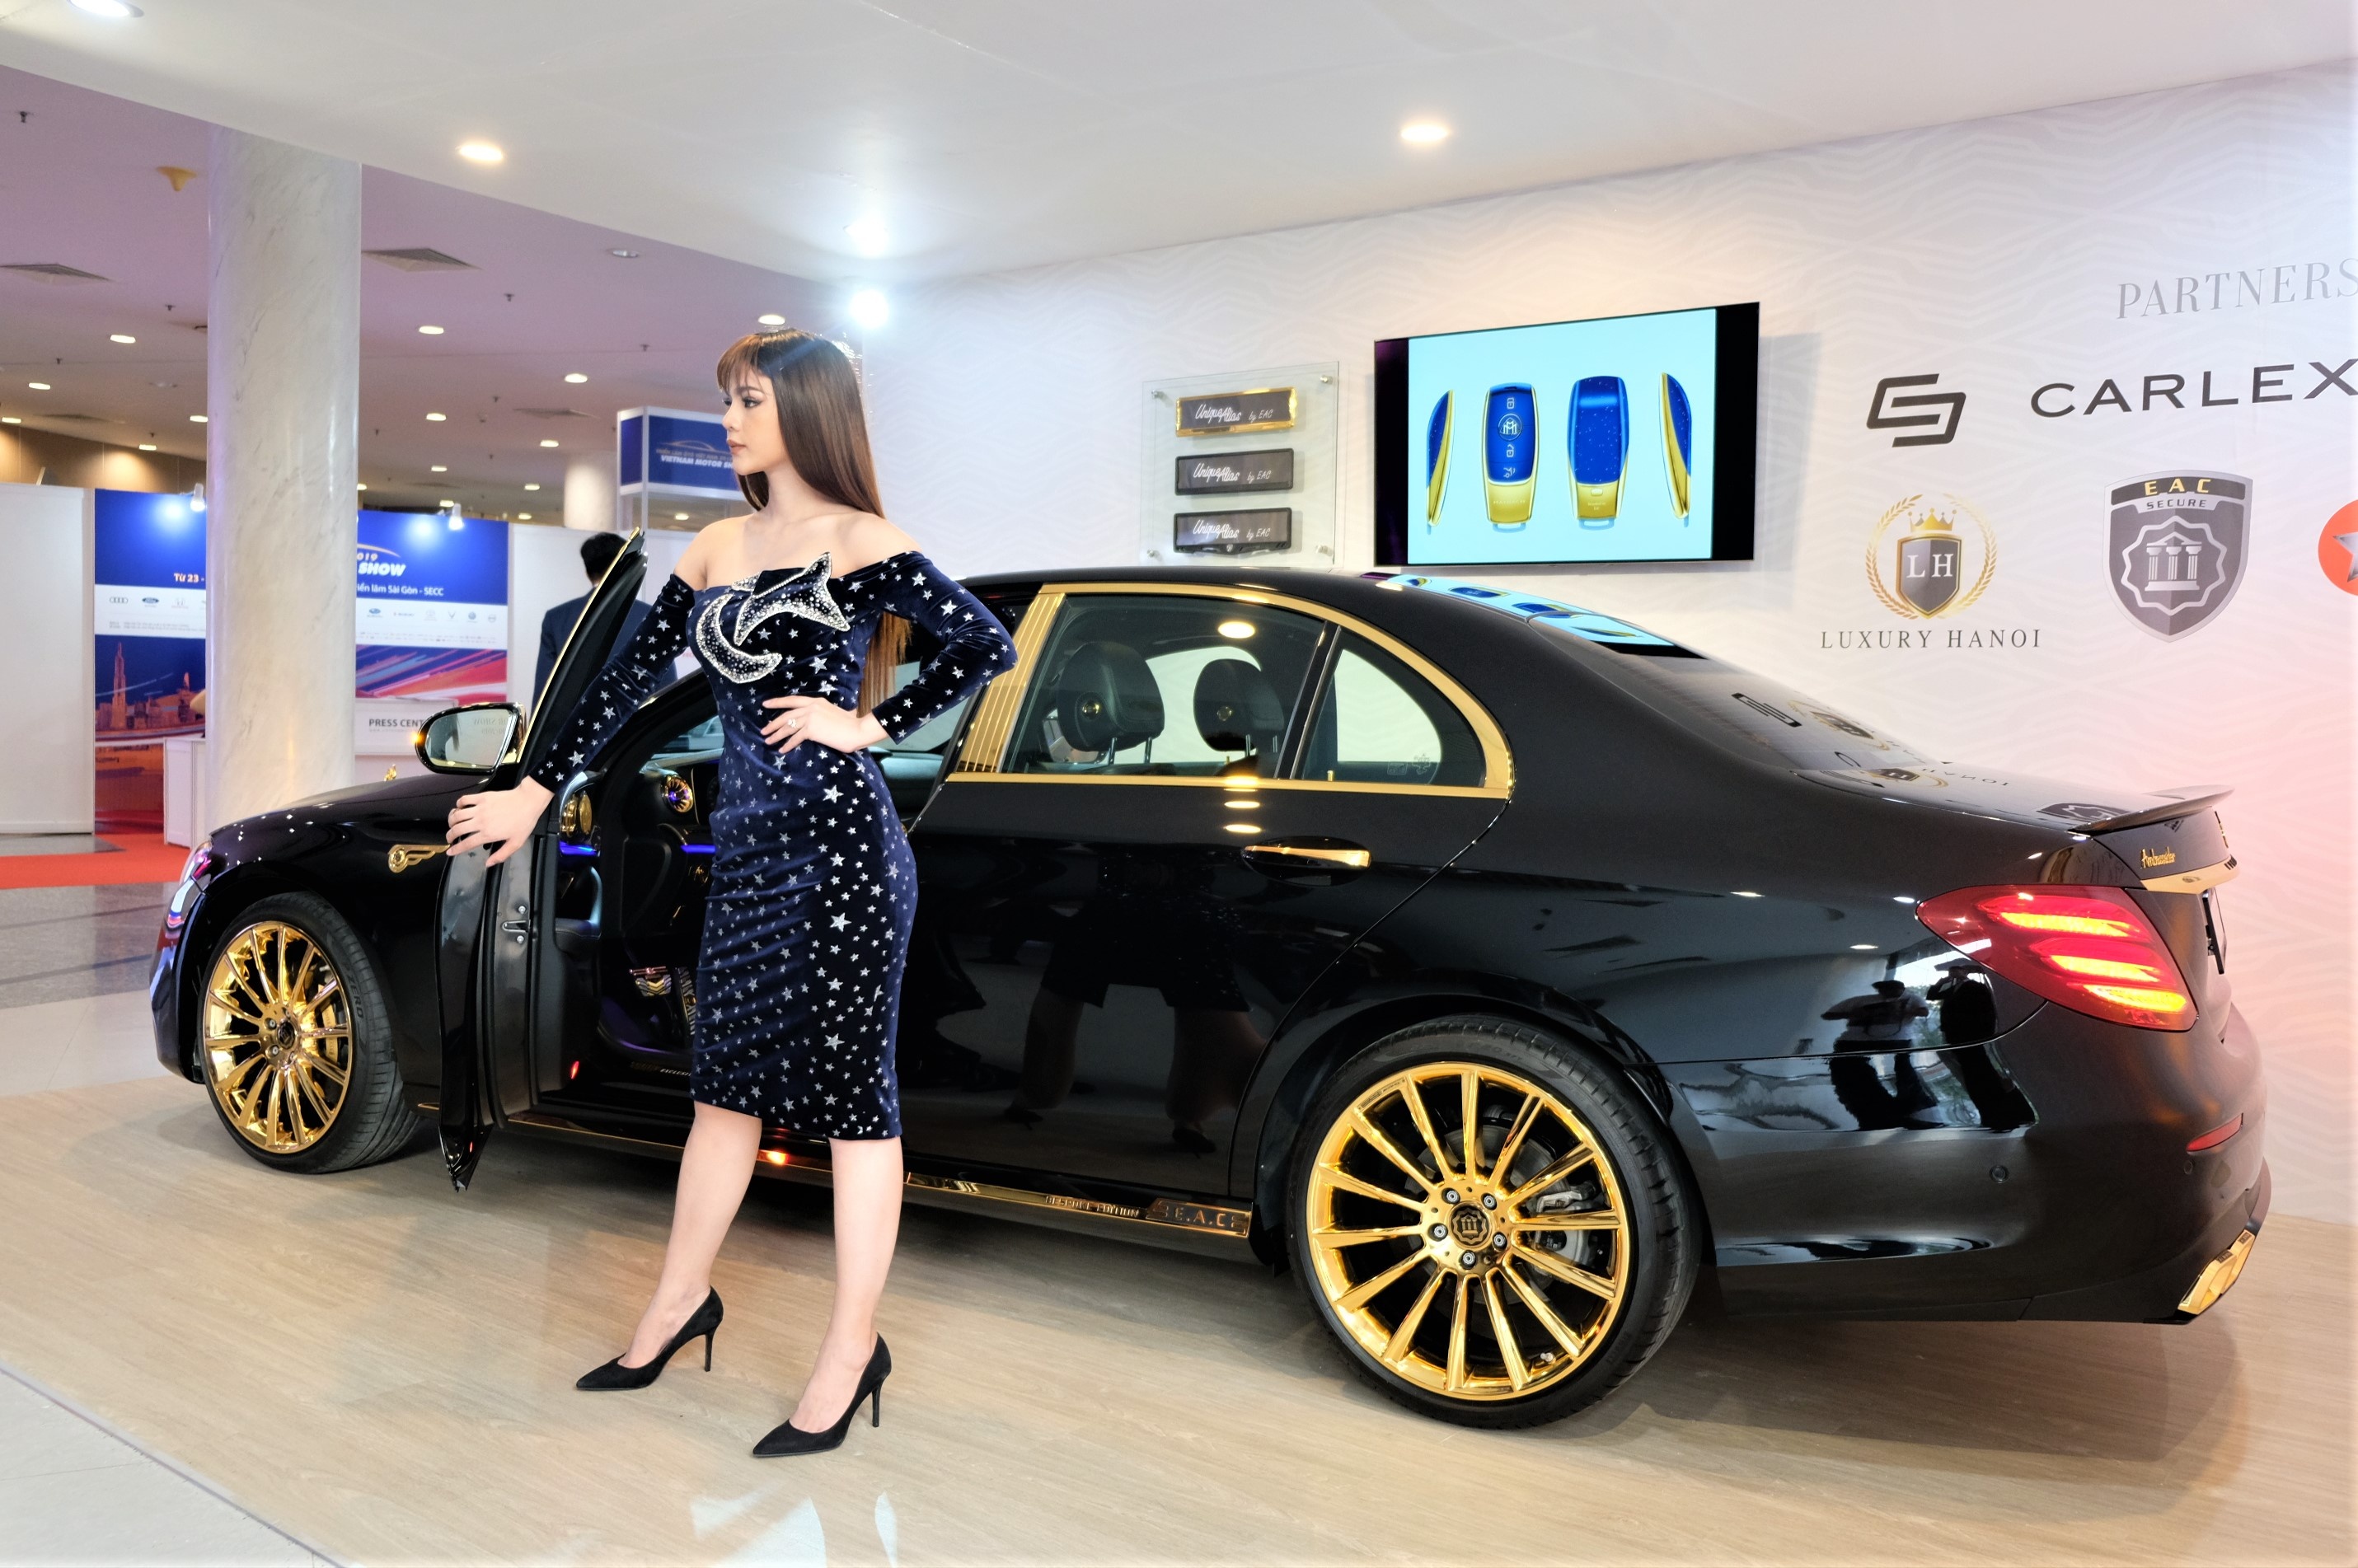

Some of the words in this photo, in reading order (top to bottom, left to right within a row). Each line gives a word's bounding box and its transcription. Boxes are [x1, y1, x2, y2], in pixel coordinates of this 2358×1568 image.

[2116, 257, 2358, 320] PARTNERS
[2031, 358, 2358, 419] CARLEX
[1249, 411, 1257, 423] by
[1259, 410, 1273, 419] EAC
[661, 455, 694, 465] VIETNAM
[695, 459, 722, 468] MOTOR
[1247, 473, 1255, 484] by
[1257, 470, 1272, 480] EAC
[2146, 498, 2207, 510] SECURE
[1246, 529, 1254, 541] by
[1256, 528, 1271, 537] EAC
[357, 553, 378, 561] 019
[358, 562, 406, 577] SHOW
[187, 574, 199, 583] 23
[401, 585, 419, 595] Gòn
[424, 587, 444, 596] SECC
[1821, 630, 1933, 649] LUXURY
[1948, 629, 2041, 648] HANOI
[368, 718, 397, 727] PRESS
[400, 719, 424, 728] CENT
[346, 974, 364, 1018] ZERO
